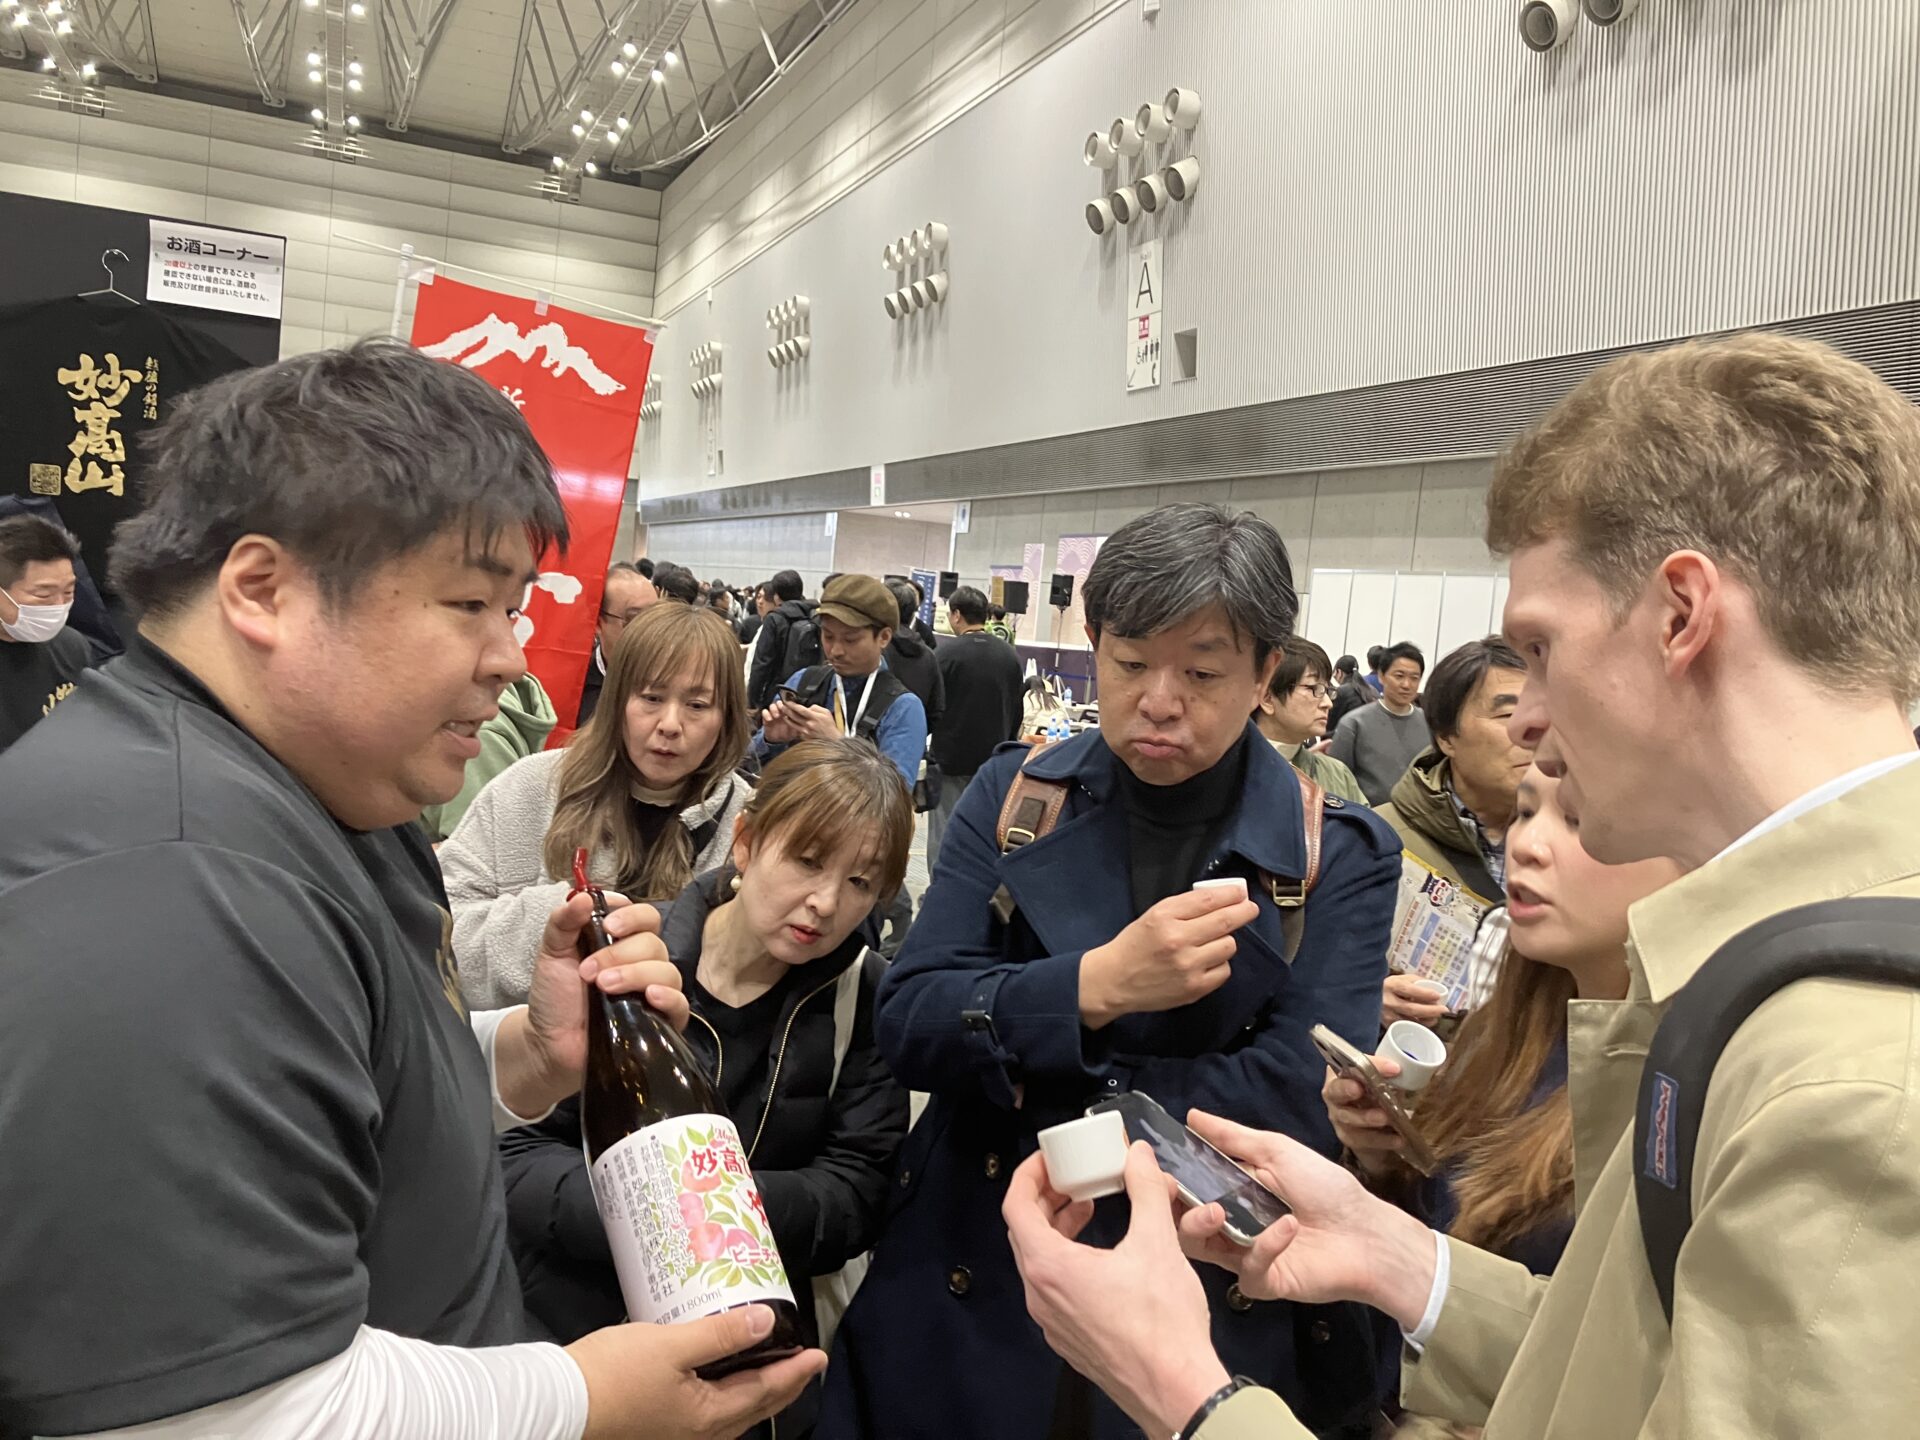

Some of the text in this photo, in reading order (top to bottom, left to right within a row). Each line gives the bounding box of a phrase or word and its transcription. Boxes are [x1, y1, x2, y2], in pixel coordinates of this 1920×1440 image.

[167, 236, 270, 261] お酒コーナー
[1136, 261, 1154, 309] A
[57, 353, 144, 497] 妙高山
